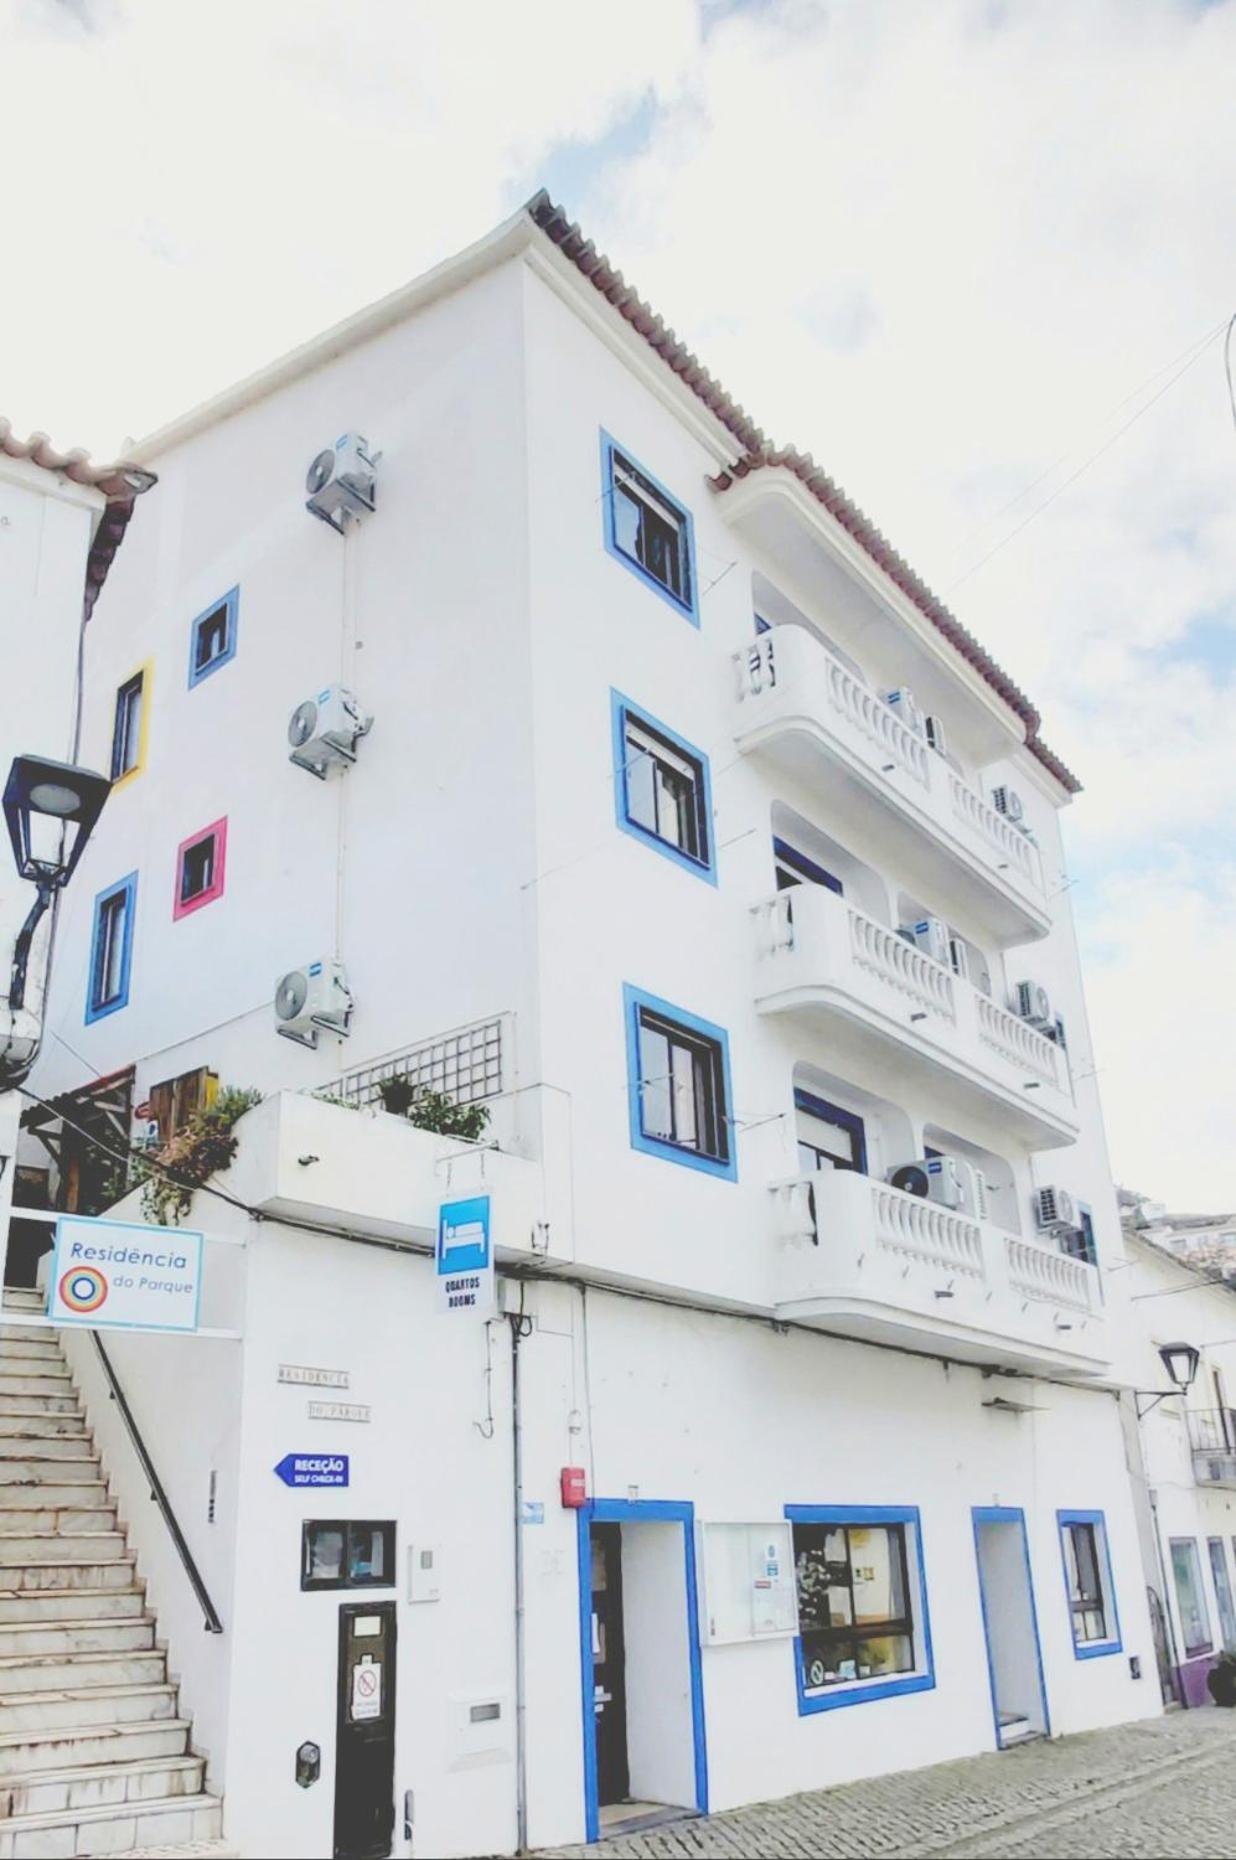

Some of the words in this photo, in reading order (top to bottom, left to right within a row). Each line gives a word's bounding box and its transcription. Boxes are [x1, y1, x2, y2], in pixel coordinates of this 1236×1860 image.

[70, 1242, 187, 1269] Residência
[113, 1275, 134, 1289] do
[139, 1278, 193, 1294] Parque
[445, 1277, 480, 1293] QUARTOS
[449, 1294, 476, 1308] ROOMS
[295, 1458, 344, 1474] RECEÇÃO
